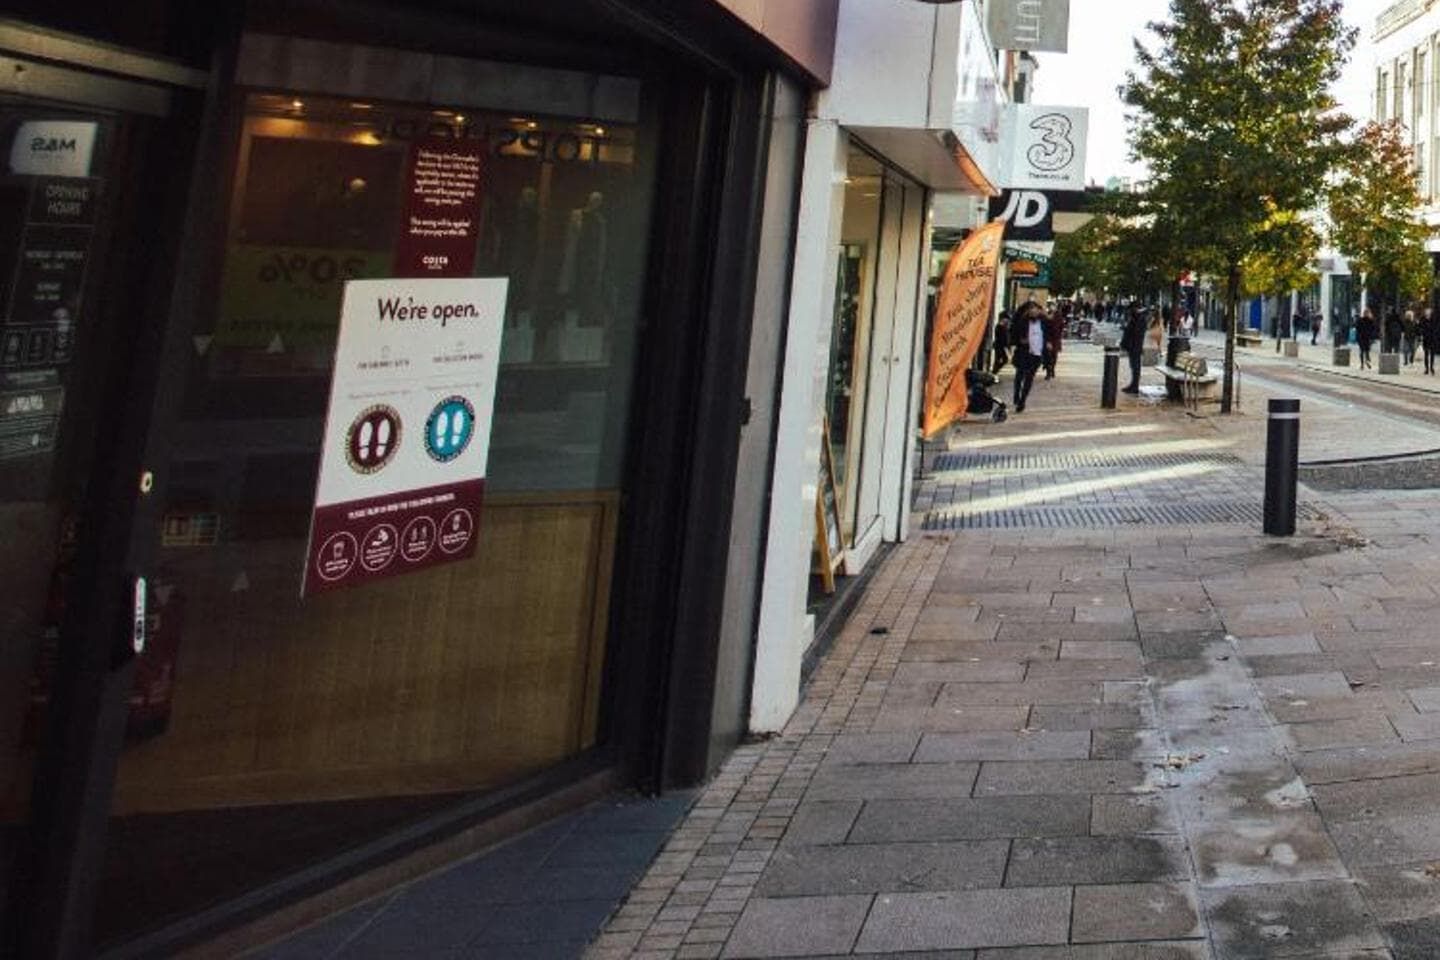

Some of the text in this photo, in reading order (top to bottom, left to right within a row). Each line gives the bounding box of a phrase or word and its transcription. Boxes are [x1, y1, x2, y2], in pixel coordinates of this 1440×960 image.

[1027, 112, 1075, 171] 3
[994, 191, 1049, 227] JD
[378, 297, 479, 327] We're open.
